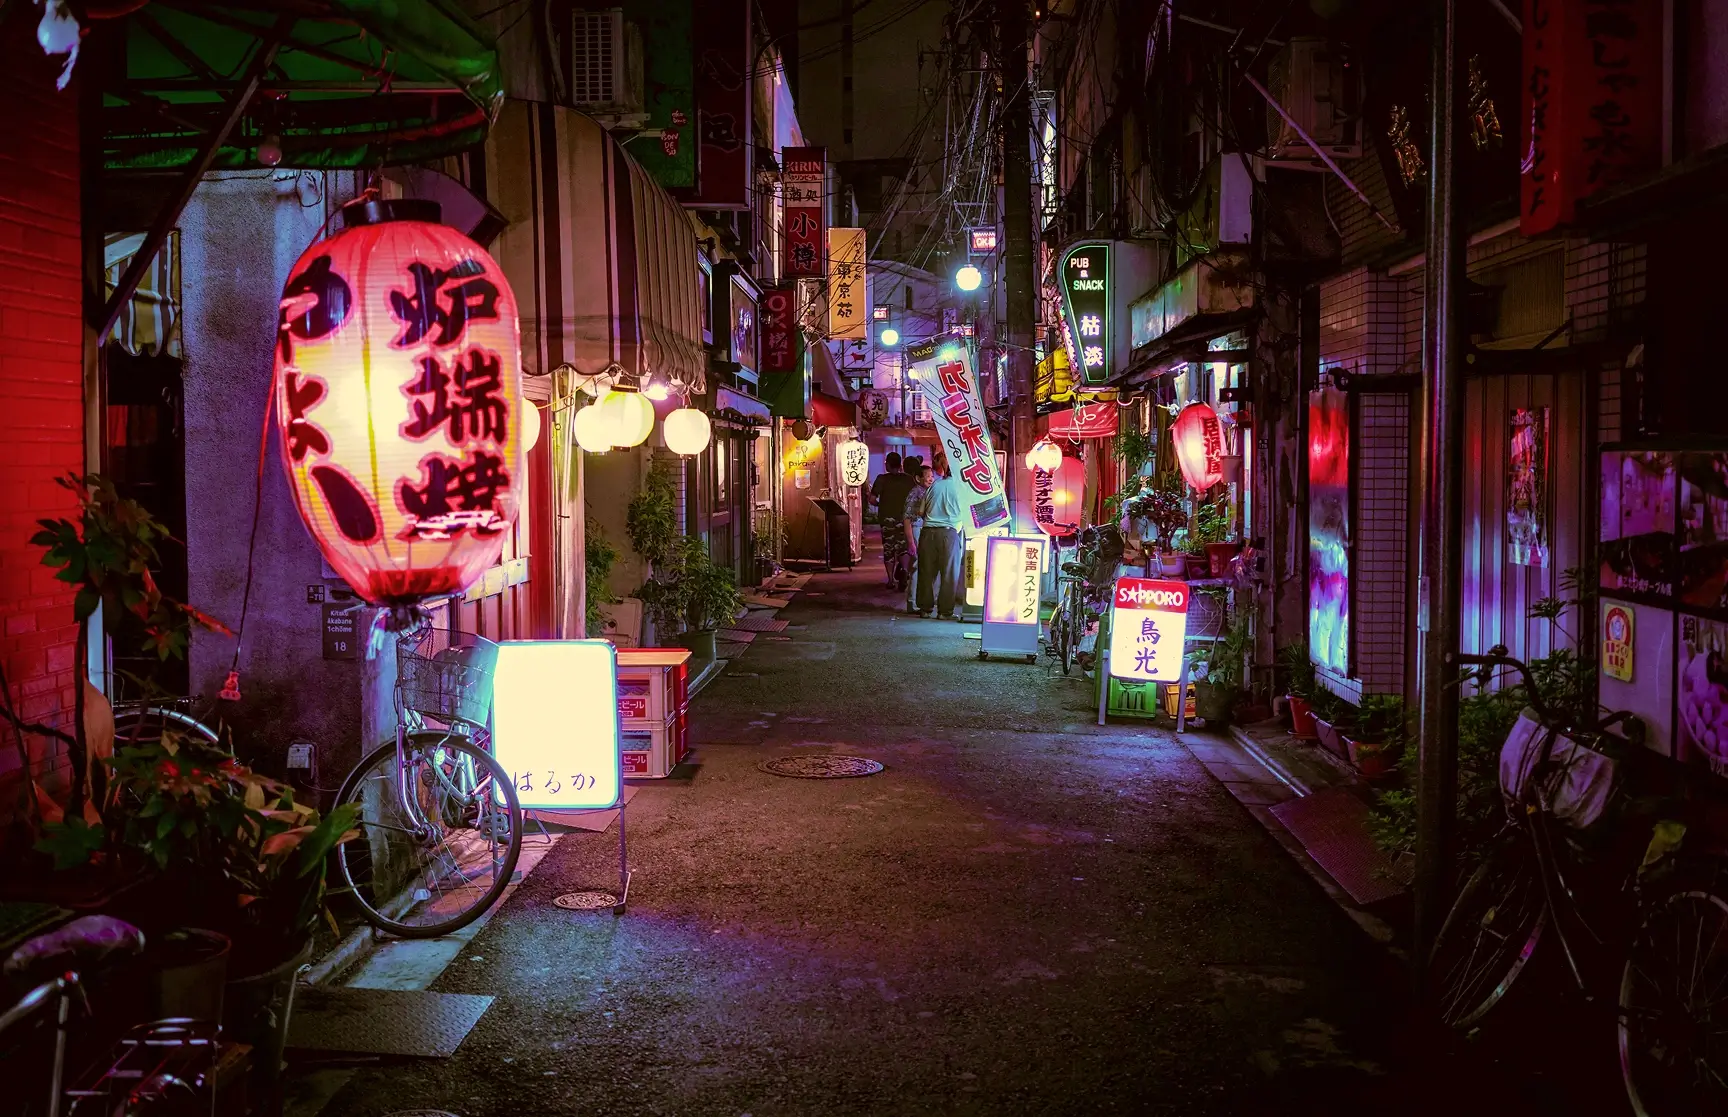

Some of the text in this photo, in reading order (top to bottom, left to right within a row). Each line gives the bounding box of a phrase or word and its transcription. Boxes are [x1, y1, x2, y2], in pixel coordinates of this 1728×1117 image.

[786, 161, 820, 172] KIRIN
[789, 185, 818, 202] 酒処
[789, 211, 818, 270] 小樽
[1070, 257, 1090, 268] PUB
[1080, 269, 1089, 278] &
[836, 263, 852, 318] 東京苑
[1073, 279, 1104, 291] SNACK
[1080, 315, 1104, 367] 枯淡
[390, 259, 511, 540] 炉端焼
[1035, 468, 1055, 525] カラオケ酒場
[1022, 546, 1039, 619] 歌声スナック
[327, 617, 353, 625] Akabane
[334, 641, 347, 652] 18
[1133, 616, 1162, 675] 鳥光
[623, 755, 646, 764] ビール
[513, 771, 596, 794] はるか
